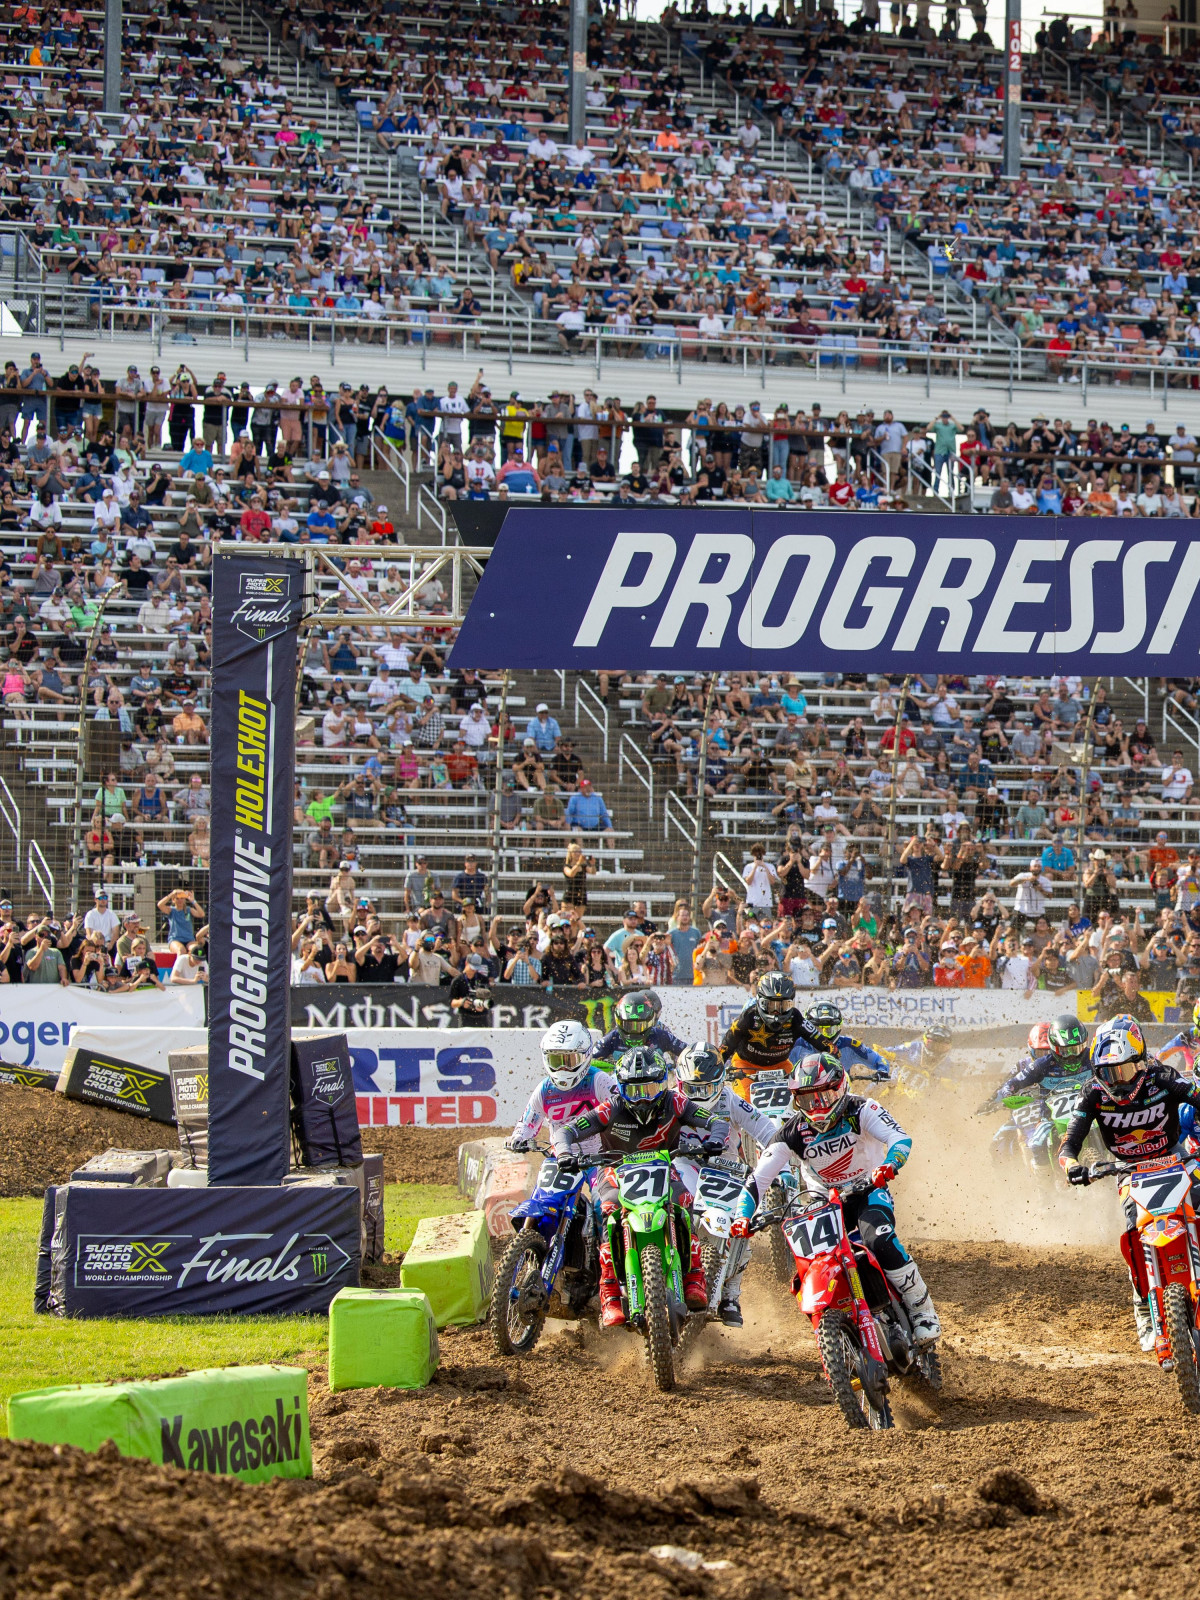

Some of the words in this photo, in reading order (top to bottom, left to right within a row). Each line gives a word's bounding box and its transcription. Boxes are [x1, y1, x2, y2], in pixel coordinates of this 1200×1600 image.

[1010, 22, 1020, 70] 102
[230, 597, 291, 623] Finals
[235, 689, 268, 831] HOLESHOT
[228, 836, 272, 1081] PROGRESSIVE
[305, 996, 551, 1028] MONSER
[87, 1065, 127, 1081] SUPER
[88, 1072, 124, 1088] MOTO
[311, 1073, 344, 1096] Finals
[83, 1079, 122, 1095] CROSS
[752, 1087, 792, 1108] 28
[82, 1088, 104, 1100] WORLD
[104, 1093, 151, 1113] CHAMPIONSHIP
[1100, 1102, 1166, 1128] THOR
[1117, 1143, 1142, 1156] Red
[1144, 1136, 1168, 1153] Bull
[538, 1164, 575, 1191] 36
[624, 1168, 667, 1200] 21
[822, 1168, 864, 1183] HONDA
[699, 1177, 741, 1202] 27
[1141, 1174, 1183, 1210] 7
[791, 1213, 840, 1257] 14
[85, 1244, 133, 1253] SUPER
[88, 1253, 131, 1261] MOTO
[177, 1232, 301, 1288] Finals
[84, 1261, 131, 1270] CROSS
[543, 1245, 559, 1281] DUNLOP
[160, 1395, 302, 1474] Kawasaki
